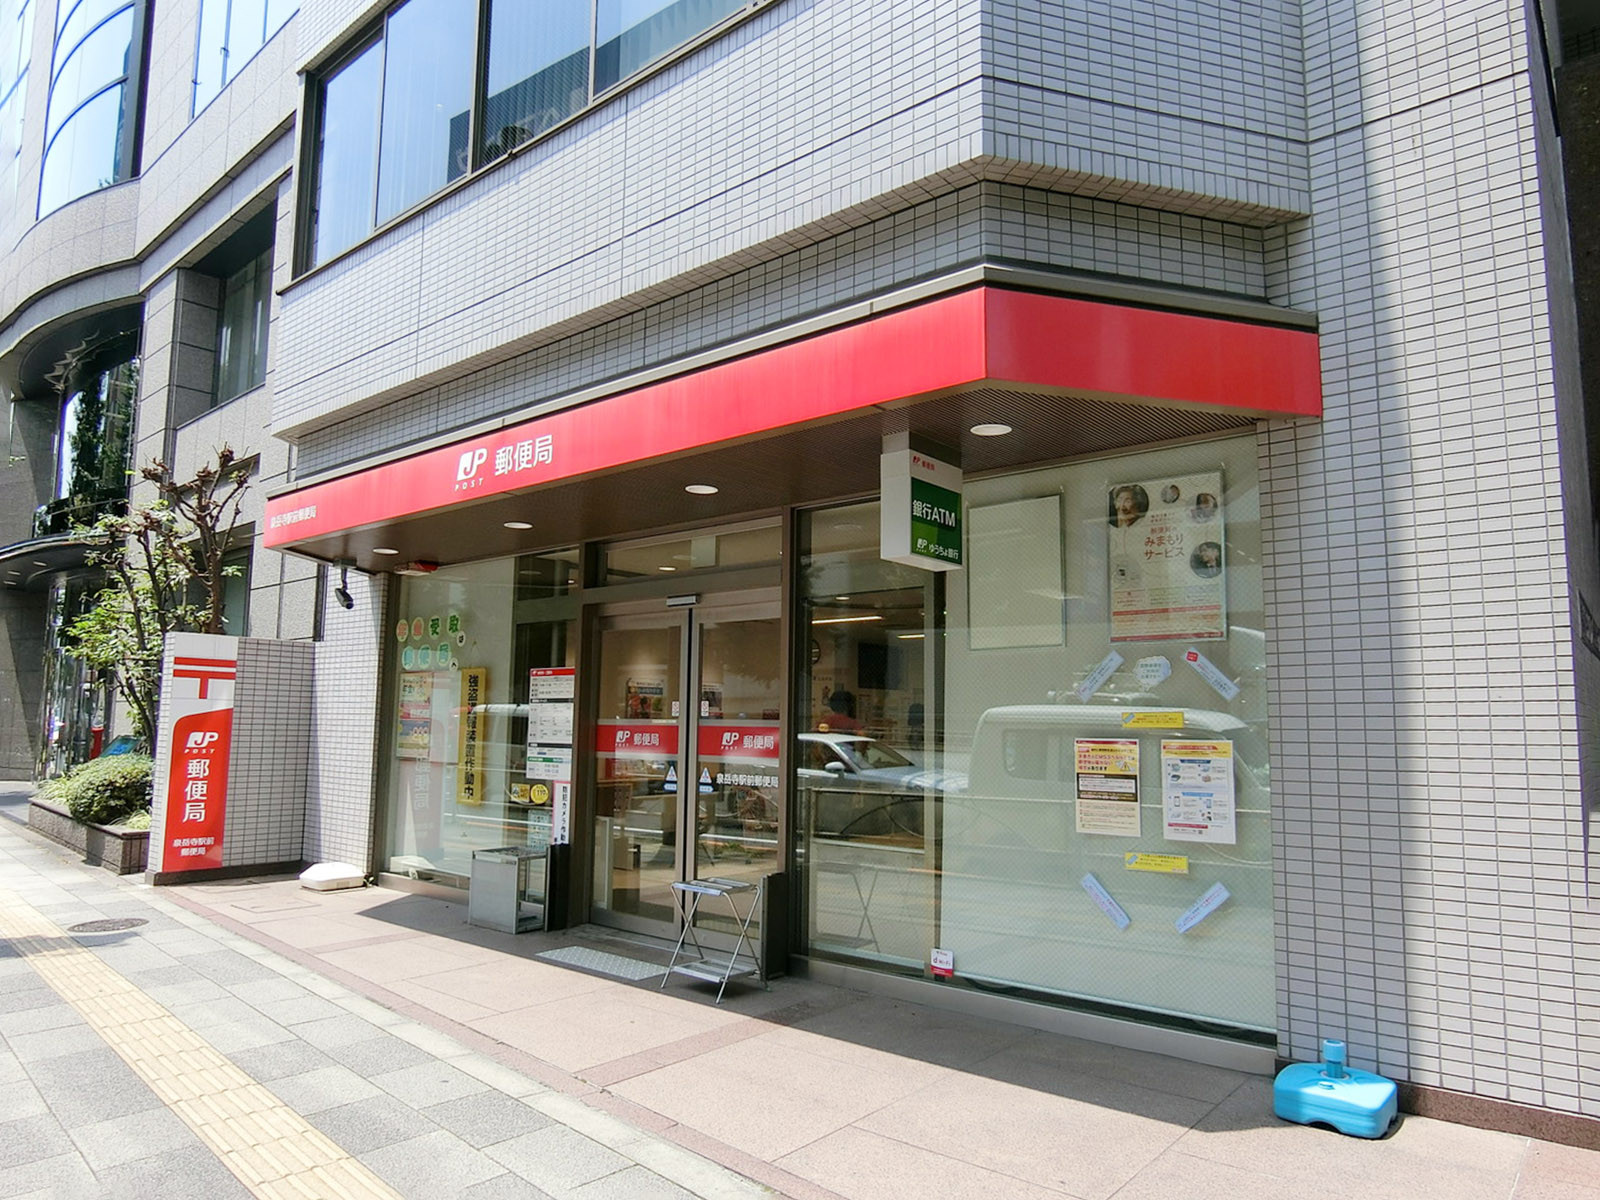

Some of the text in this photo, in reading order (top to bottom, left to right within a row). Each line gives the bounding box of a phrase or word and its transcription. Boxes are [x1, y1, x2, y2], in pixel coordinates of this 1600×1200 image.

[494, 434, 553, 477] 郵便局
[454, 478, 484, 491] POST
[912, 499, 956, 528] 銀行ATM
[1143, 533, 1185, 548] みまもり
[928, 543, 960, 560] ゆうちょ銀行
[1143, 546, 1185, 560] サービス
[633, 733, 660, 746] 郵便局
[743, 735, 775, 750] 郵便局
[716, 773, 779, 788] 泉岳寺駅前郵便局
[182, 758, 211, 824] 郵便局
[560, 785, 568, 845] 防犯カメラ作動
[173, 836, 215, 848] 泉岳寺駅前
[181, 846, 206, 856] 郵便局
